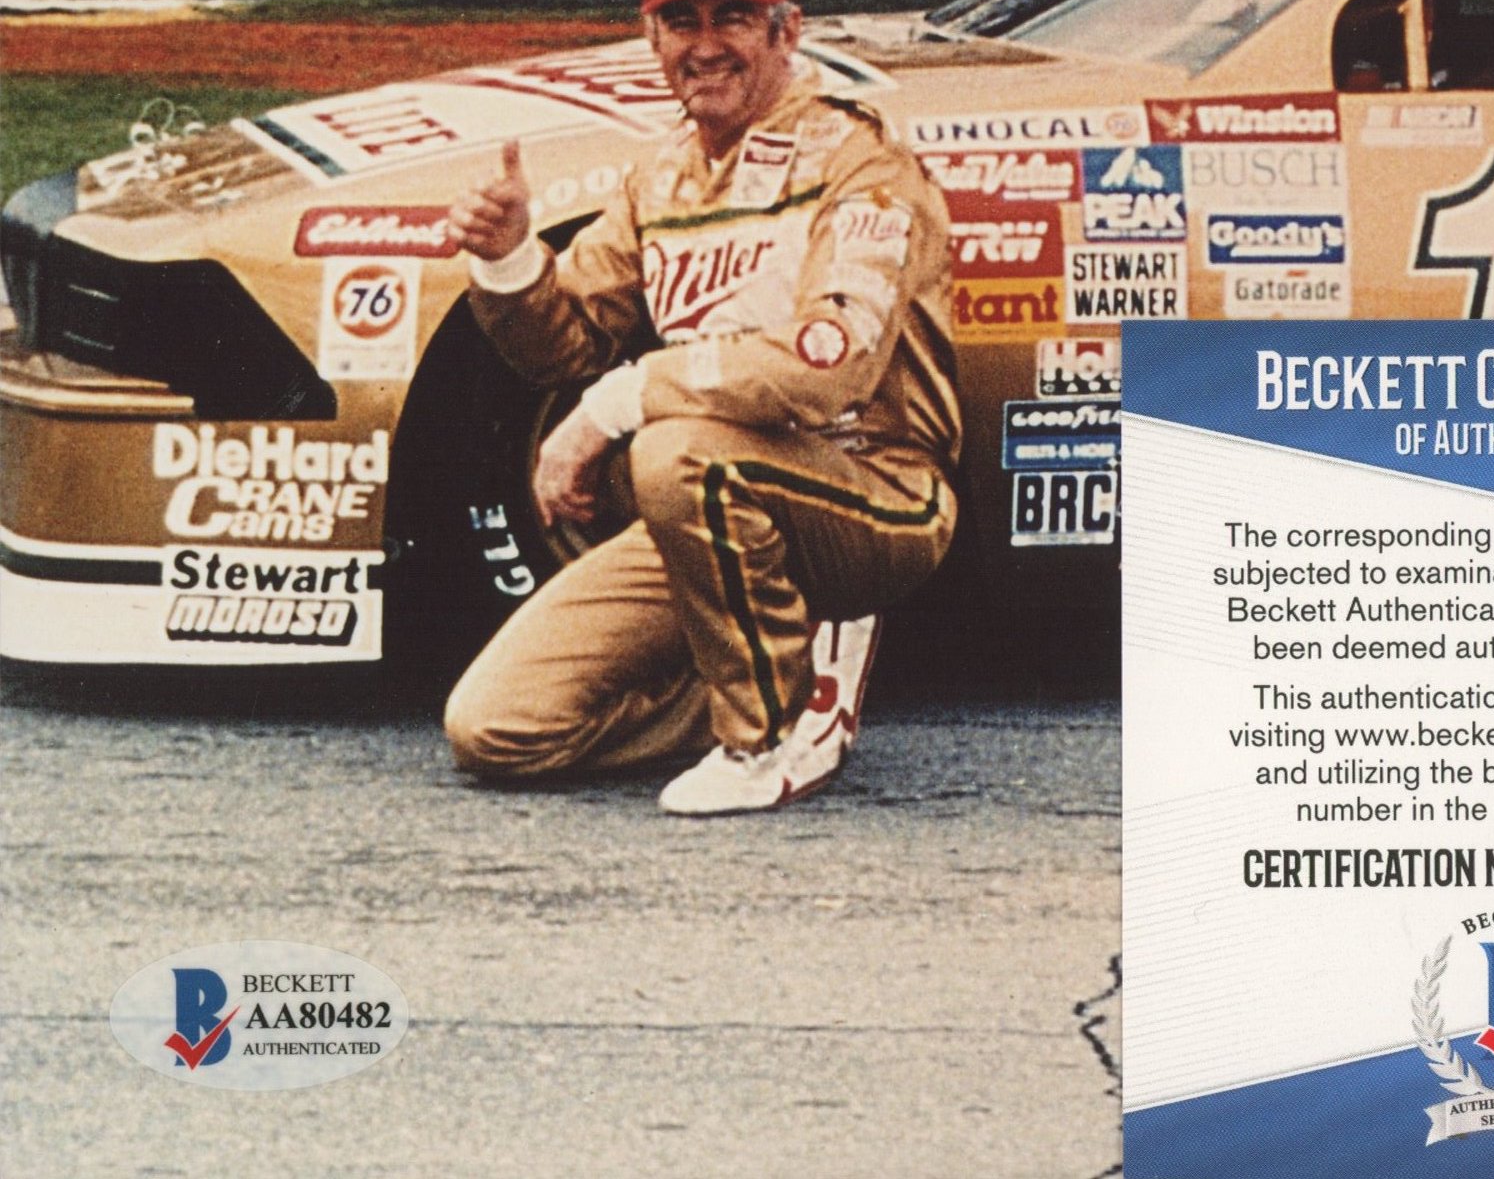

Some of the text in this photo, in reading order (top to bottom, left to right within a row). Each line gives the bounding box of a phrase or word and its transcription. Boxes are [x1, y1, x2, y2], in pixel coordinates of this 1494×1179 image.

[915, 117, 1099, 143] UNOCAL
[1196, 103, 1337, 134] Winston
[1190, 148, 1341, 188] BUSCH
[1083, 193, 1185, 229] PEAK
[1208, 221, 1344, 256] Goody's
[1072, 251, 1179, 282] STEWART
[351, 282, 393, 318] 76
[1073, 286, 1178, 318] WARNER
[1234, 276, 1343, 302] Gatorade
[1255, 349, 1467, 411] BECKETT
[153, 421, 389, 484] DieHard
[1224, 522, 1277, 548] The
[1287, 521, 1491, 554] corresponding
[170, 549, 362, 594] Stewart
[1213, 559, 1350, 593] subjected
[1359, 562, 1386, 585] to
[1228, 596, 1336, 622] Beckett
[1254, 634, 1322, 660] been
[1332, 633, 1446, 660] deemed
[1253, 684, 1312, 710] This
[1229, 721, 1325, 754] visiting
[1255, 759, 1307, 785] and
[1318, 759, 1420, 791] utilizing
[1429, 758, 1473, 784] the
[1297, 796, 1402, 822] number
[1412, 796, 1434, 821] in
[1444, 795, 1487, 821] the
[1243, 848, 1476, 888] CERTIFICATION
[242, 974, 356, 994] BECKETT
[245, 1001, 392, 1030] AA80482
[242, 1041, 382, 1057] AUTHENTICATED
